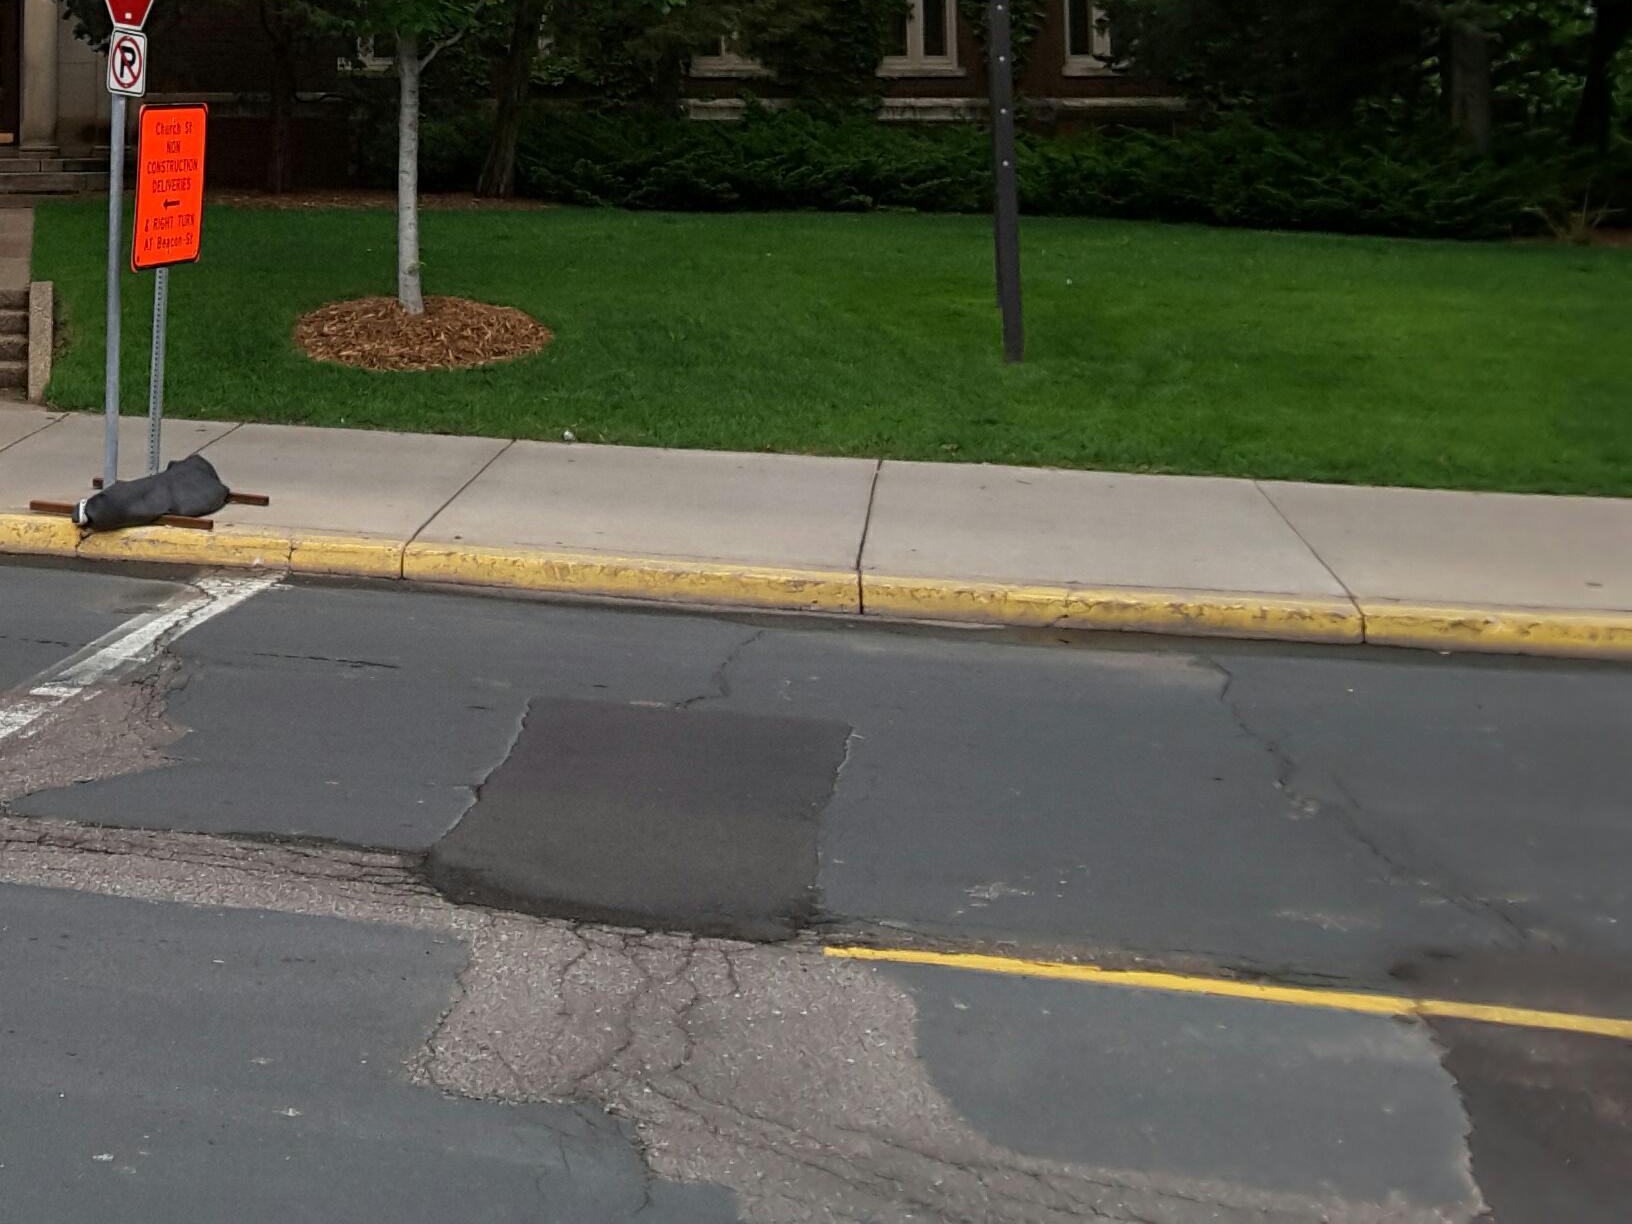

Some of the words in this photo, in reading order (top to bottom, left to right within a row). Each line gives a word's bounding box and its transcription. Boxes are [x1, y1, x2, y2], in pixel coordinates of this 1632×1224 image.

[120, 45, 135, 78] P
[155, 122, 181, 135] Church
[185, 121, 193, 134] St
[167, 141, 181, 153] NON
[147, 159, 198, 174] CONSTRUCTION
[152, 177, 191, 193] DELIVERIES
[153, 215, 173, 230] RIGHT
[178, 214, 195, 227] TURN
[144, 237, 153, 251] AT
[157, 235, 182, 250] Beacon
